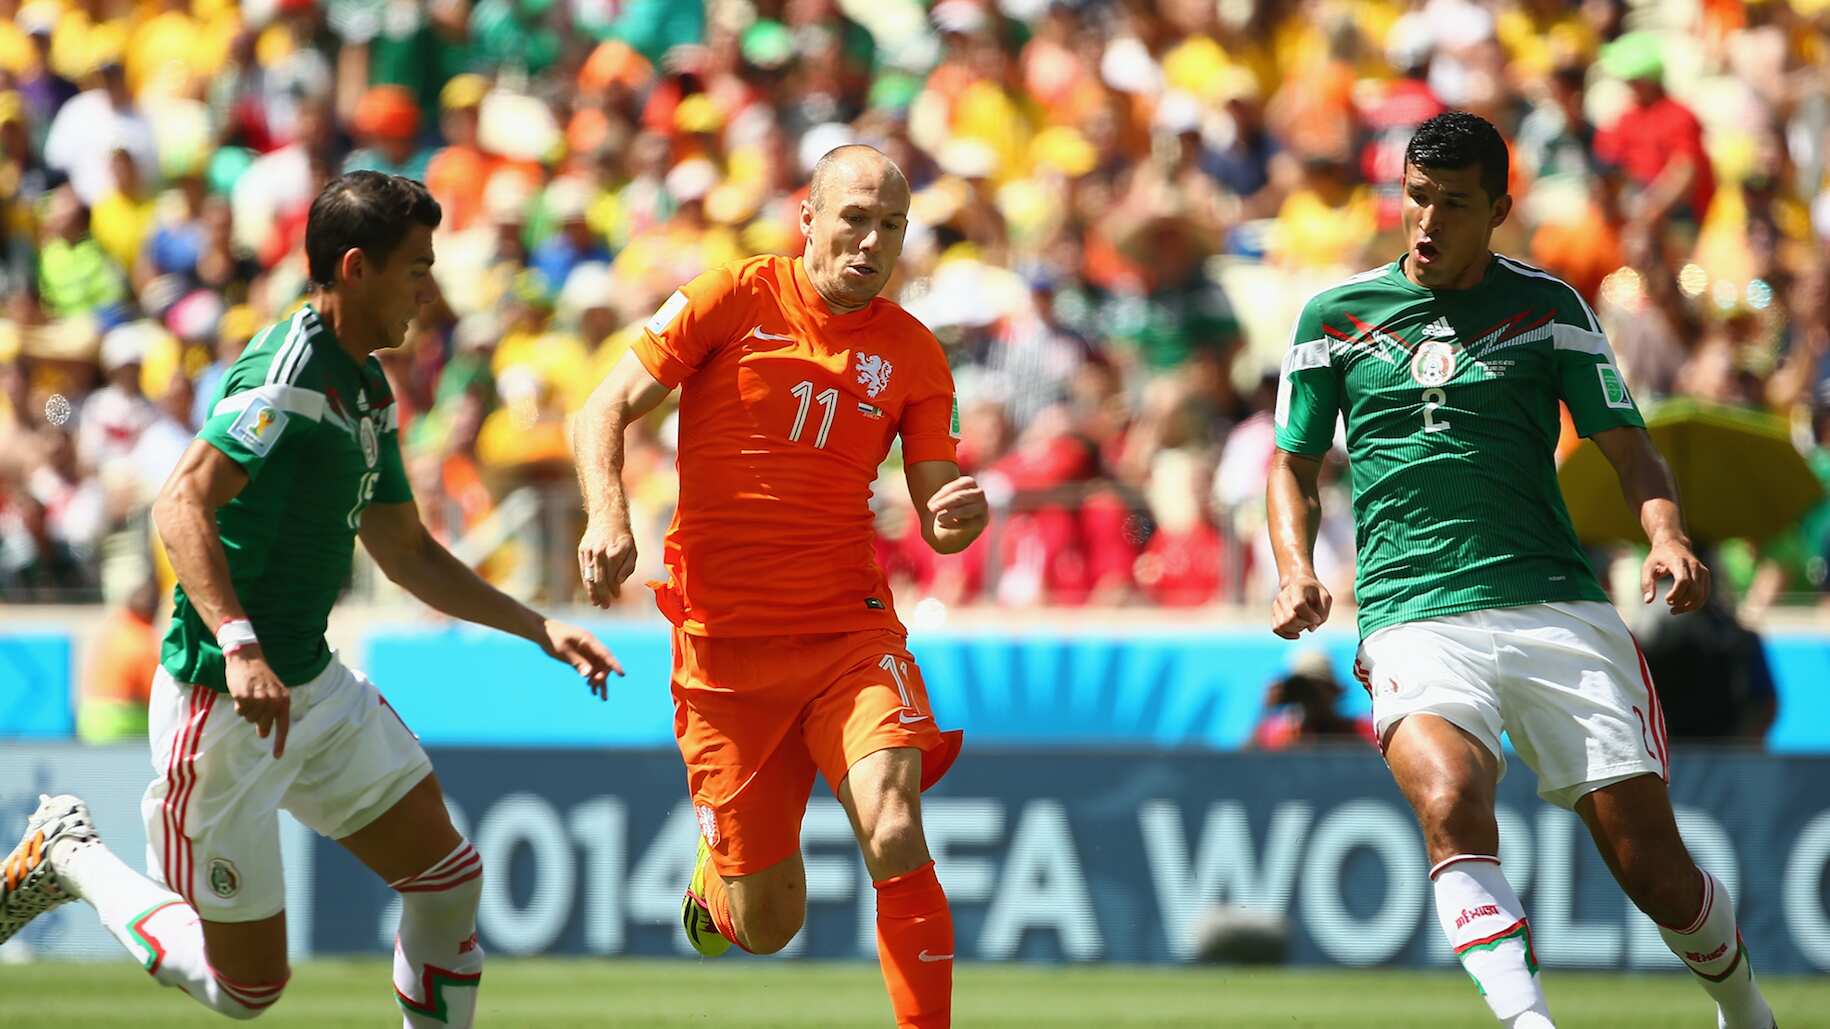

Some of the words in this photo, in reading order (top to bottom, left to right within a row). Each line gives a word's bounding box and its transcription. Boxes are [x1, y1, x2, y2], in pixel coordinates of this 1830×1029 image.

[788, 380, 840, 449] 11
[1421, 388, 1451, 433] 2
[378, 792, 703, 956] 014
